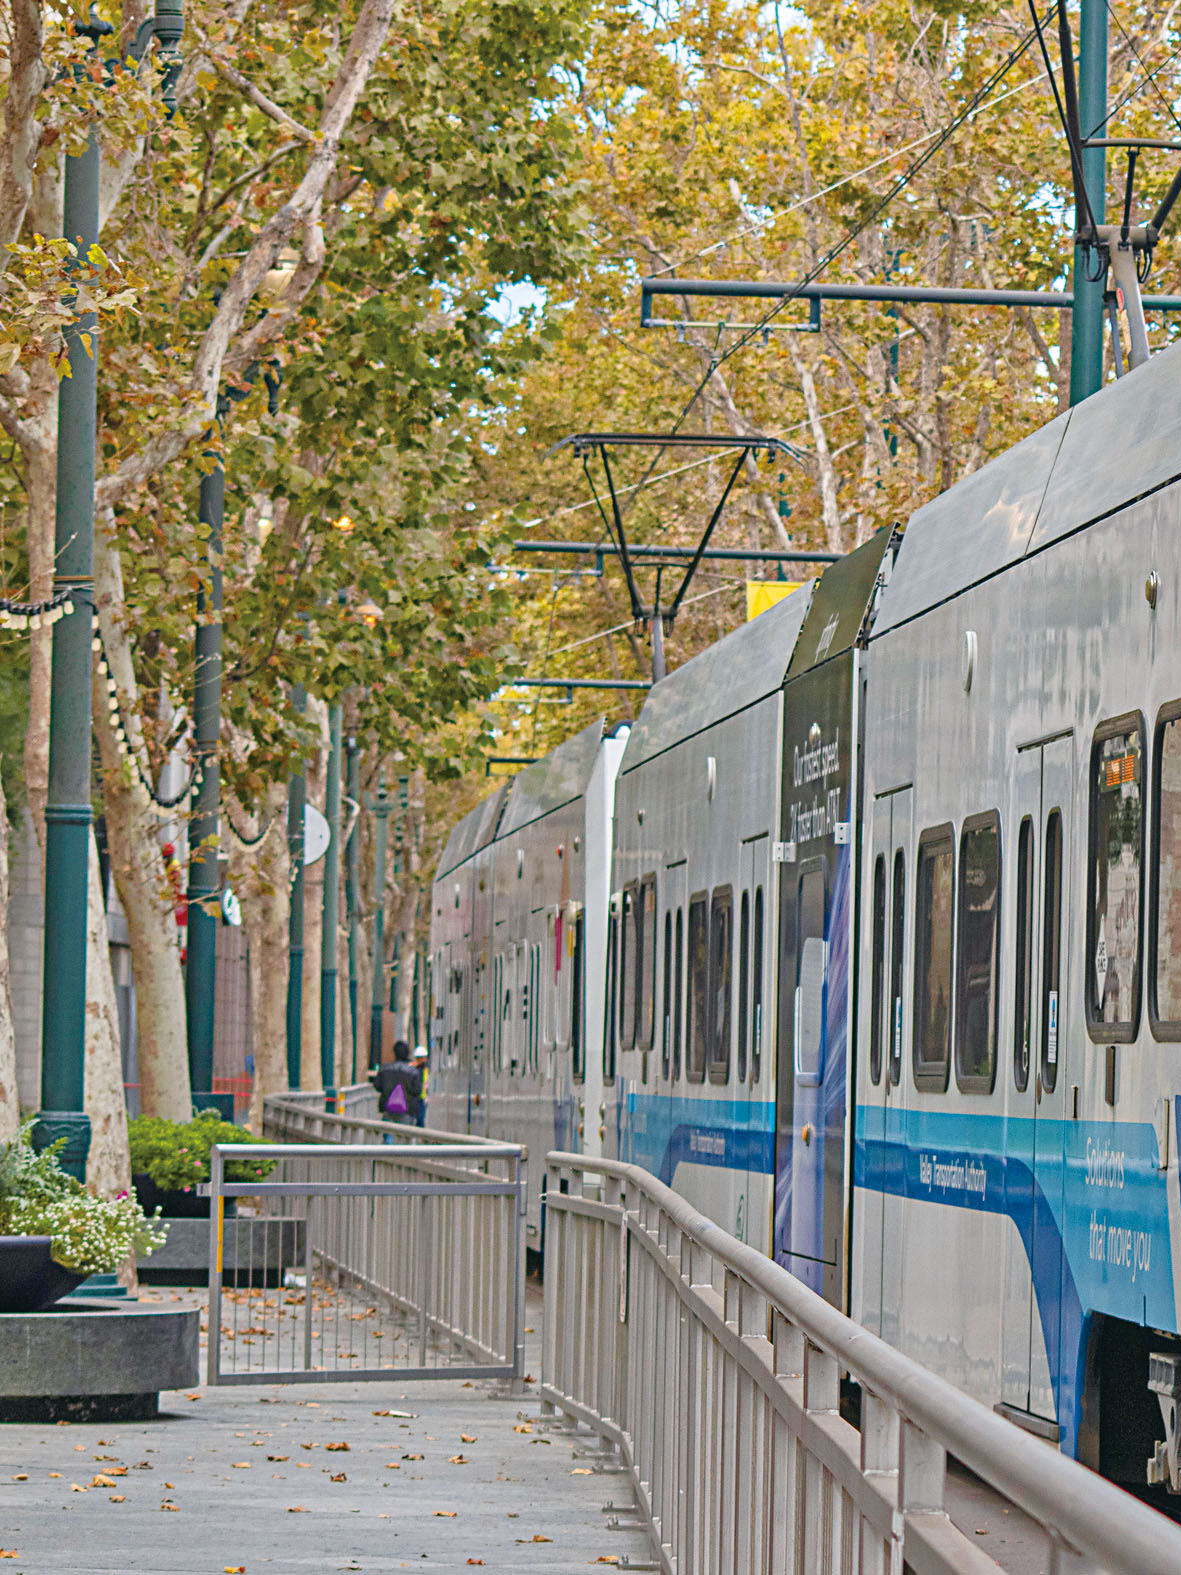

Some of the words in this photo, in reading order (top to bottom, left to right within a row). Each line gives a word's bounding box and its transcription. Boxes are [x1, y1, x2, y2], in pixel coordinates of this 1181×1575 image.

[1085, 1136, 1126, 1190] Solutions
[1089, 1209, 1107, 1262] that
[1107, 1225, 1132, 1268] move
[1131, 1230, 1152, 1284] you
